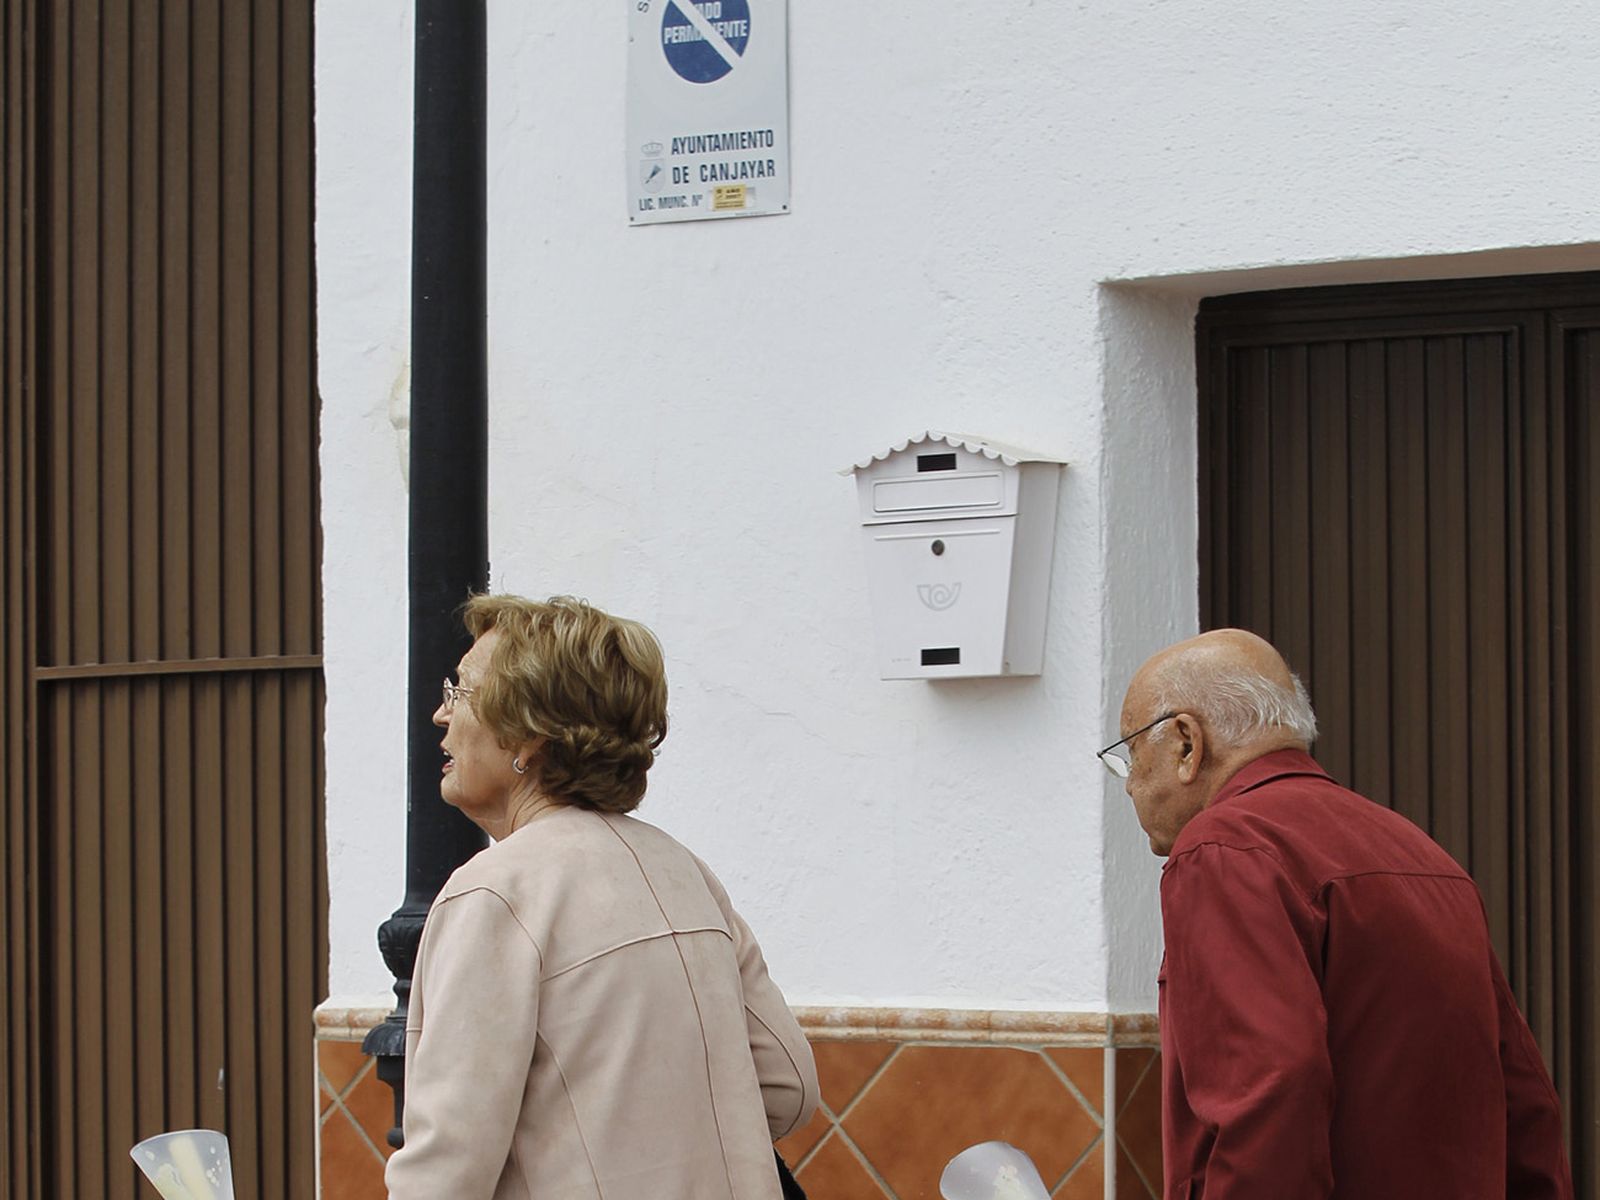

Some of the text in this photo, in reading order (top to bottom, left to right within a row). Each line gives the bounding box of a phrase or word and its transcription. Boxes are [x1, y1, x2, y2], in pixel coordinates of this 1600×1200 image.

[664, 20, 748, 44] PERMENTE
[671, 129, 774, 155] AYUNTAMIENTO
[672, 159, 776, 184] DE CANJAYAR
